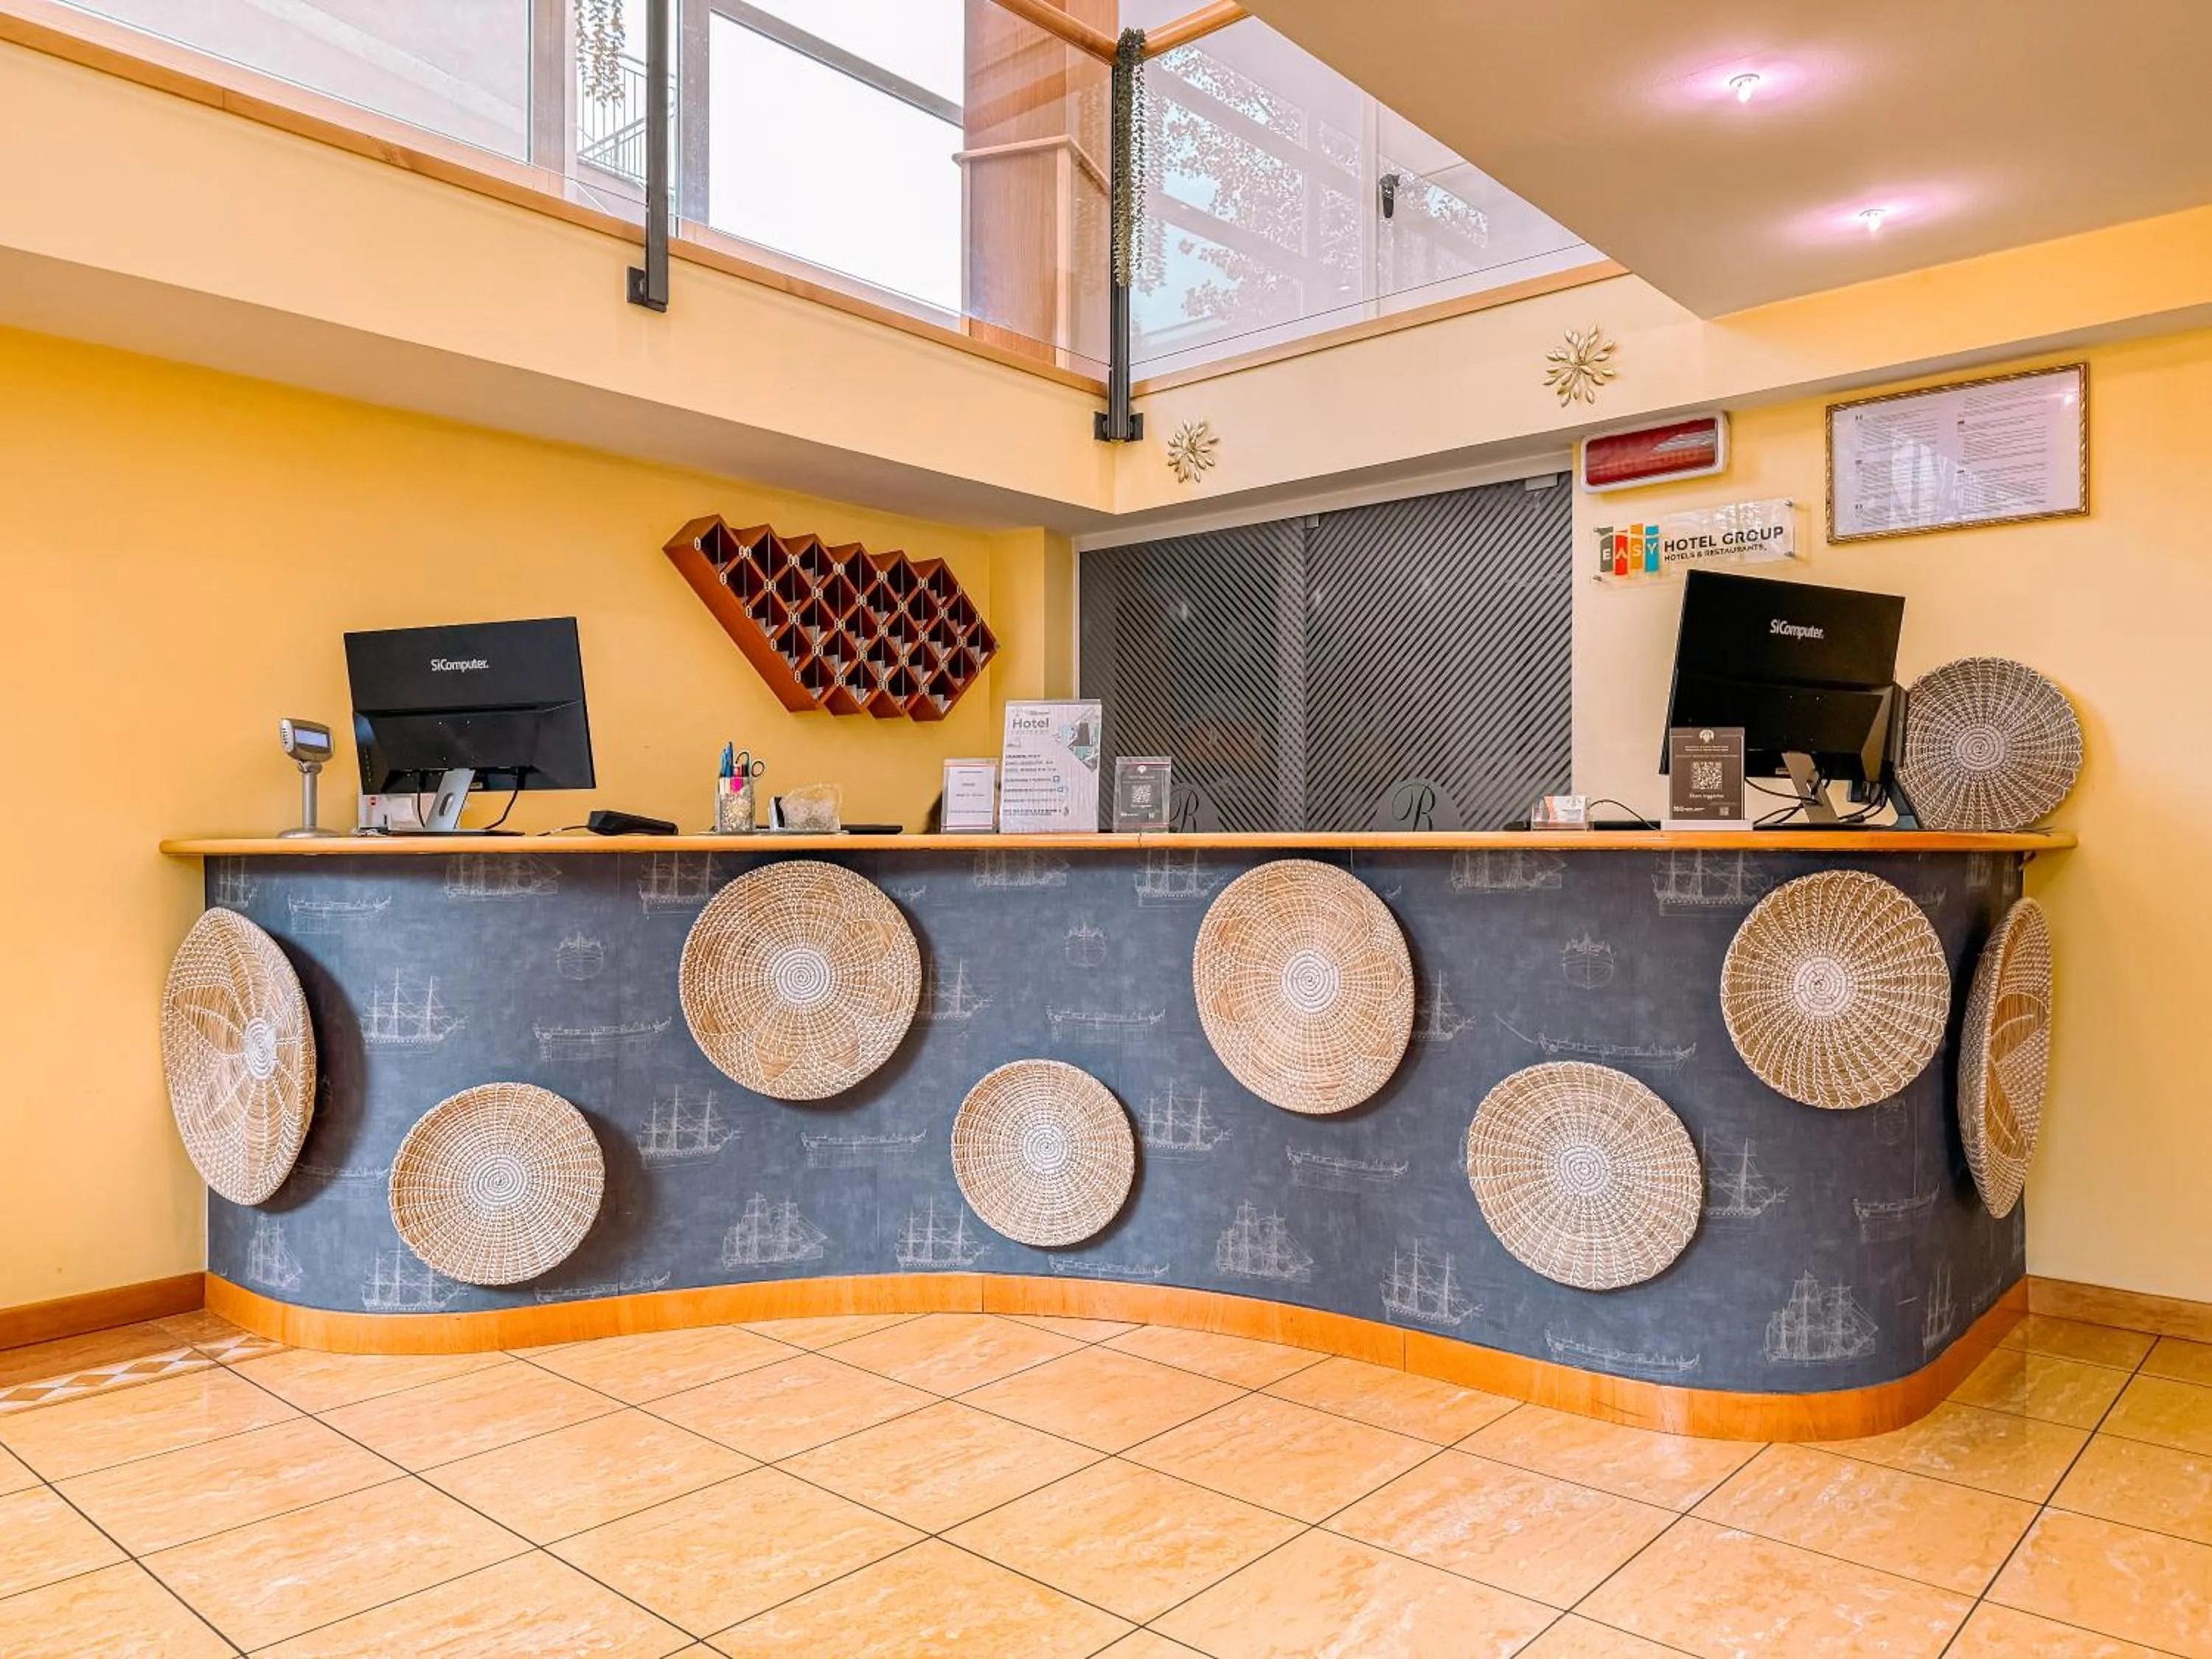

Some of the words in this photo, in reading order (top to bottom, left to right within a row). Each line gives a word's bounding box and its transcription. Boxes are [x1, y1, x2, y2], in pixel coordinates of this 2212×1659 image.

[1664, 535, 1717, 552] HOTEL
[1722, 526, 1784, 546] GROUP
[1602, 542, 1658, 560] EASY
[1664, 552, 1695, 562] HOTELS
[1012, 717, 1049, 729] Hotel
